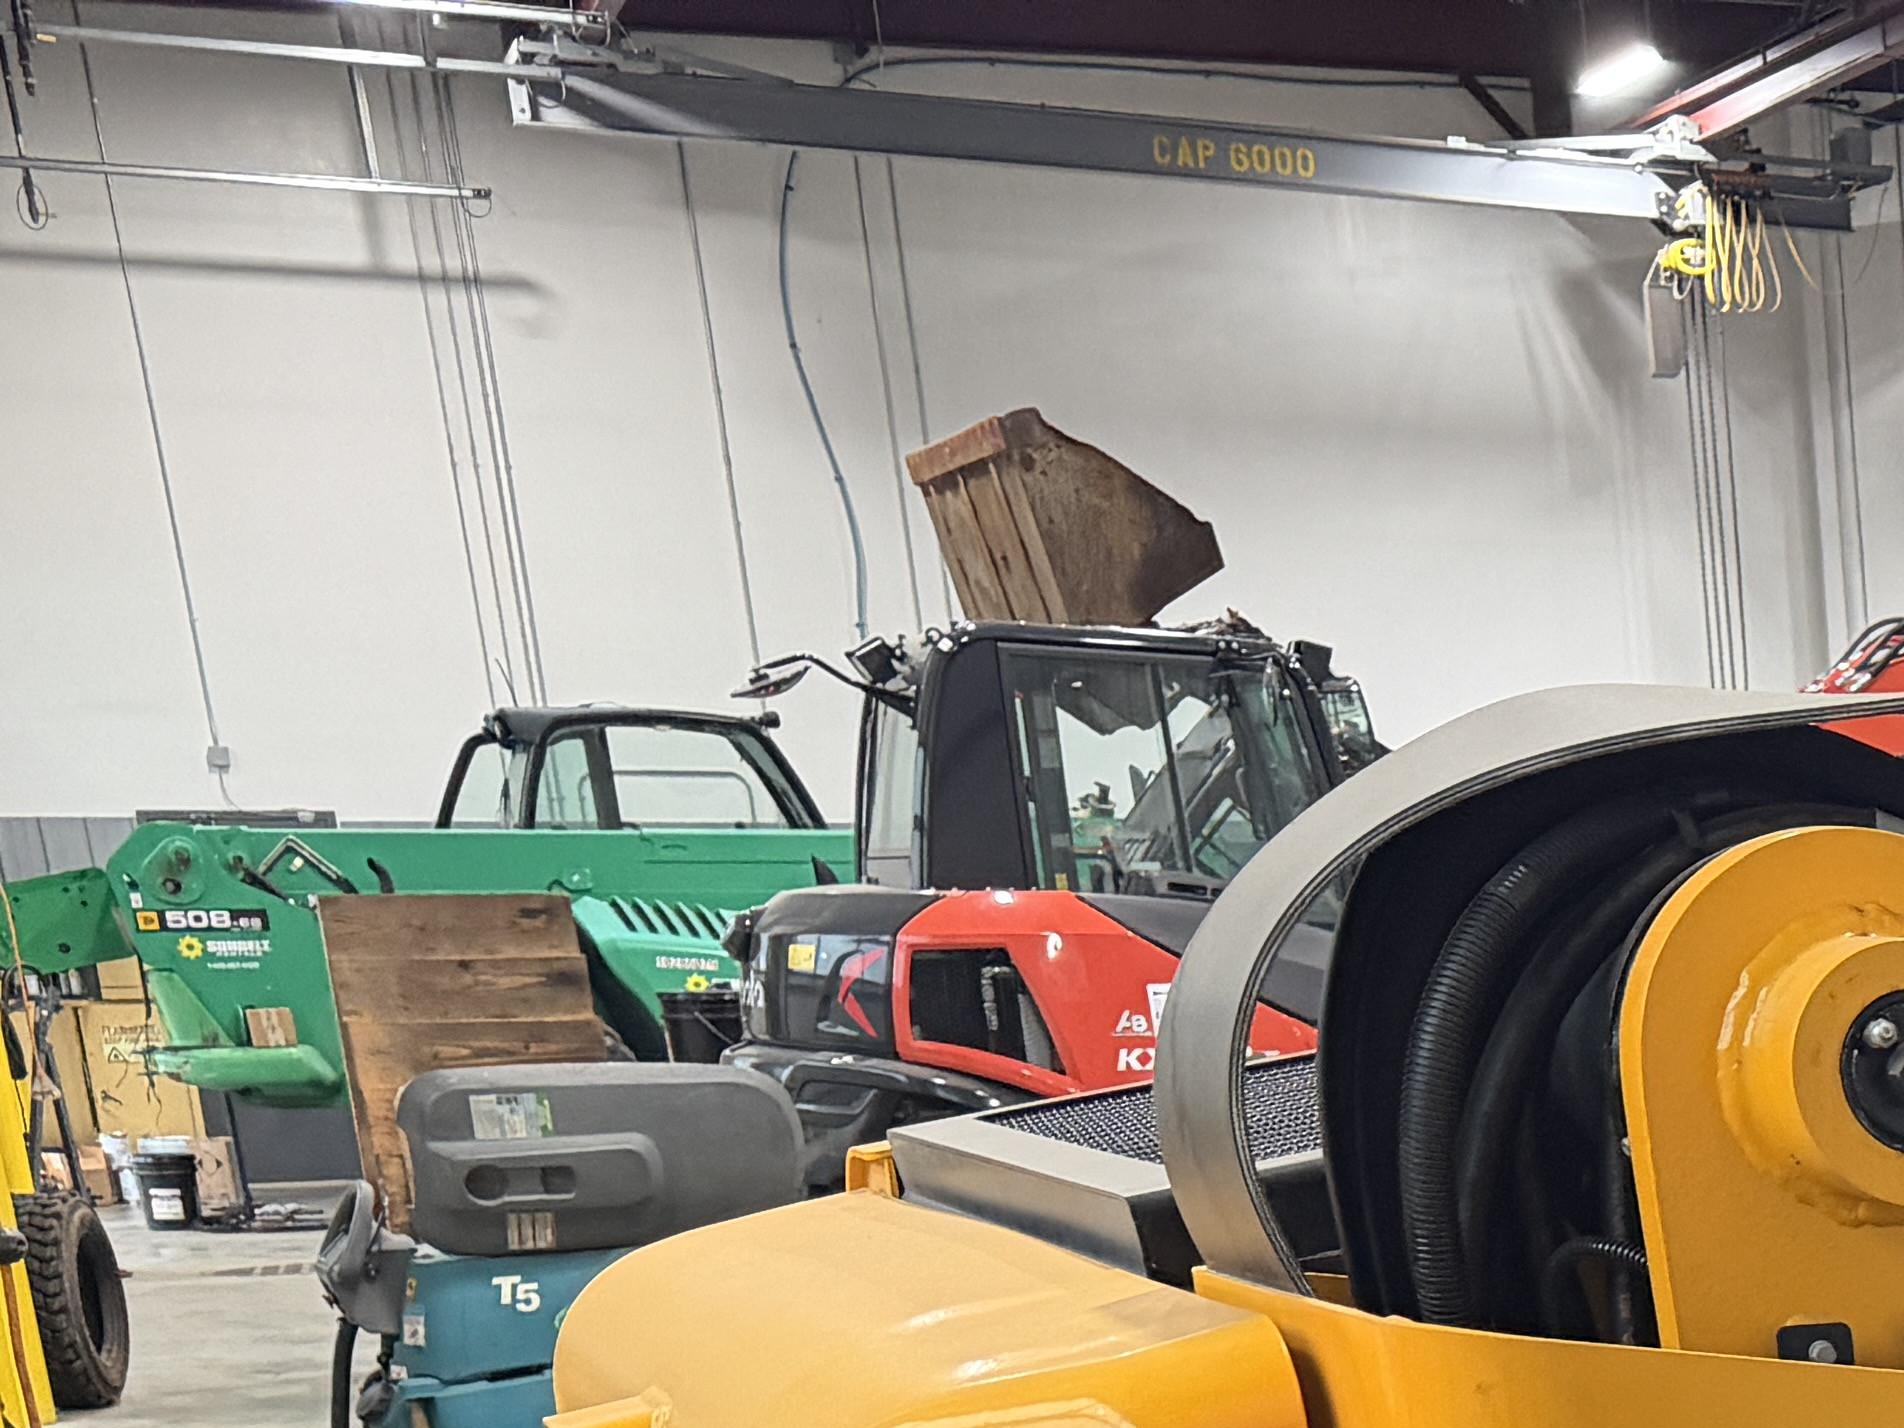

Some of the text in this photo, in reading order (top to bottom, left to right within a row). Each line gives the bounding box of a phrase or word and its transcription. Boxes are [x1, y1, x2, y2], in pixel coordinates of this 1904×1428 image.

[1153, 135, 1316, 179] CAP 6000
[491, 1274, 541, 1313] T5
